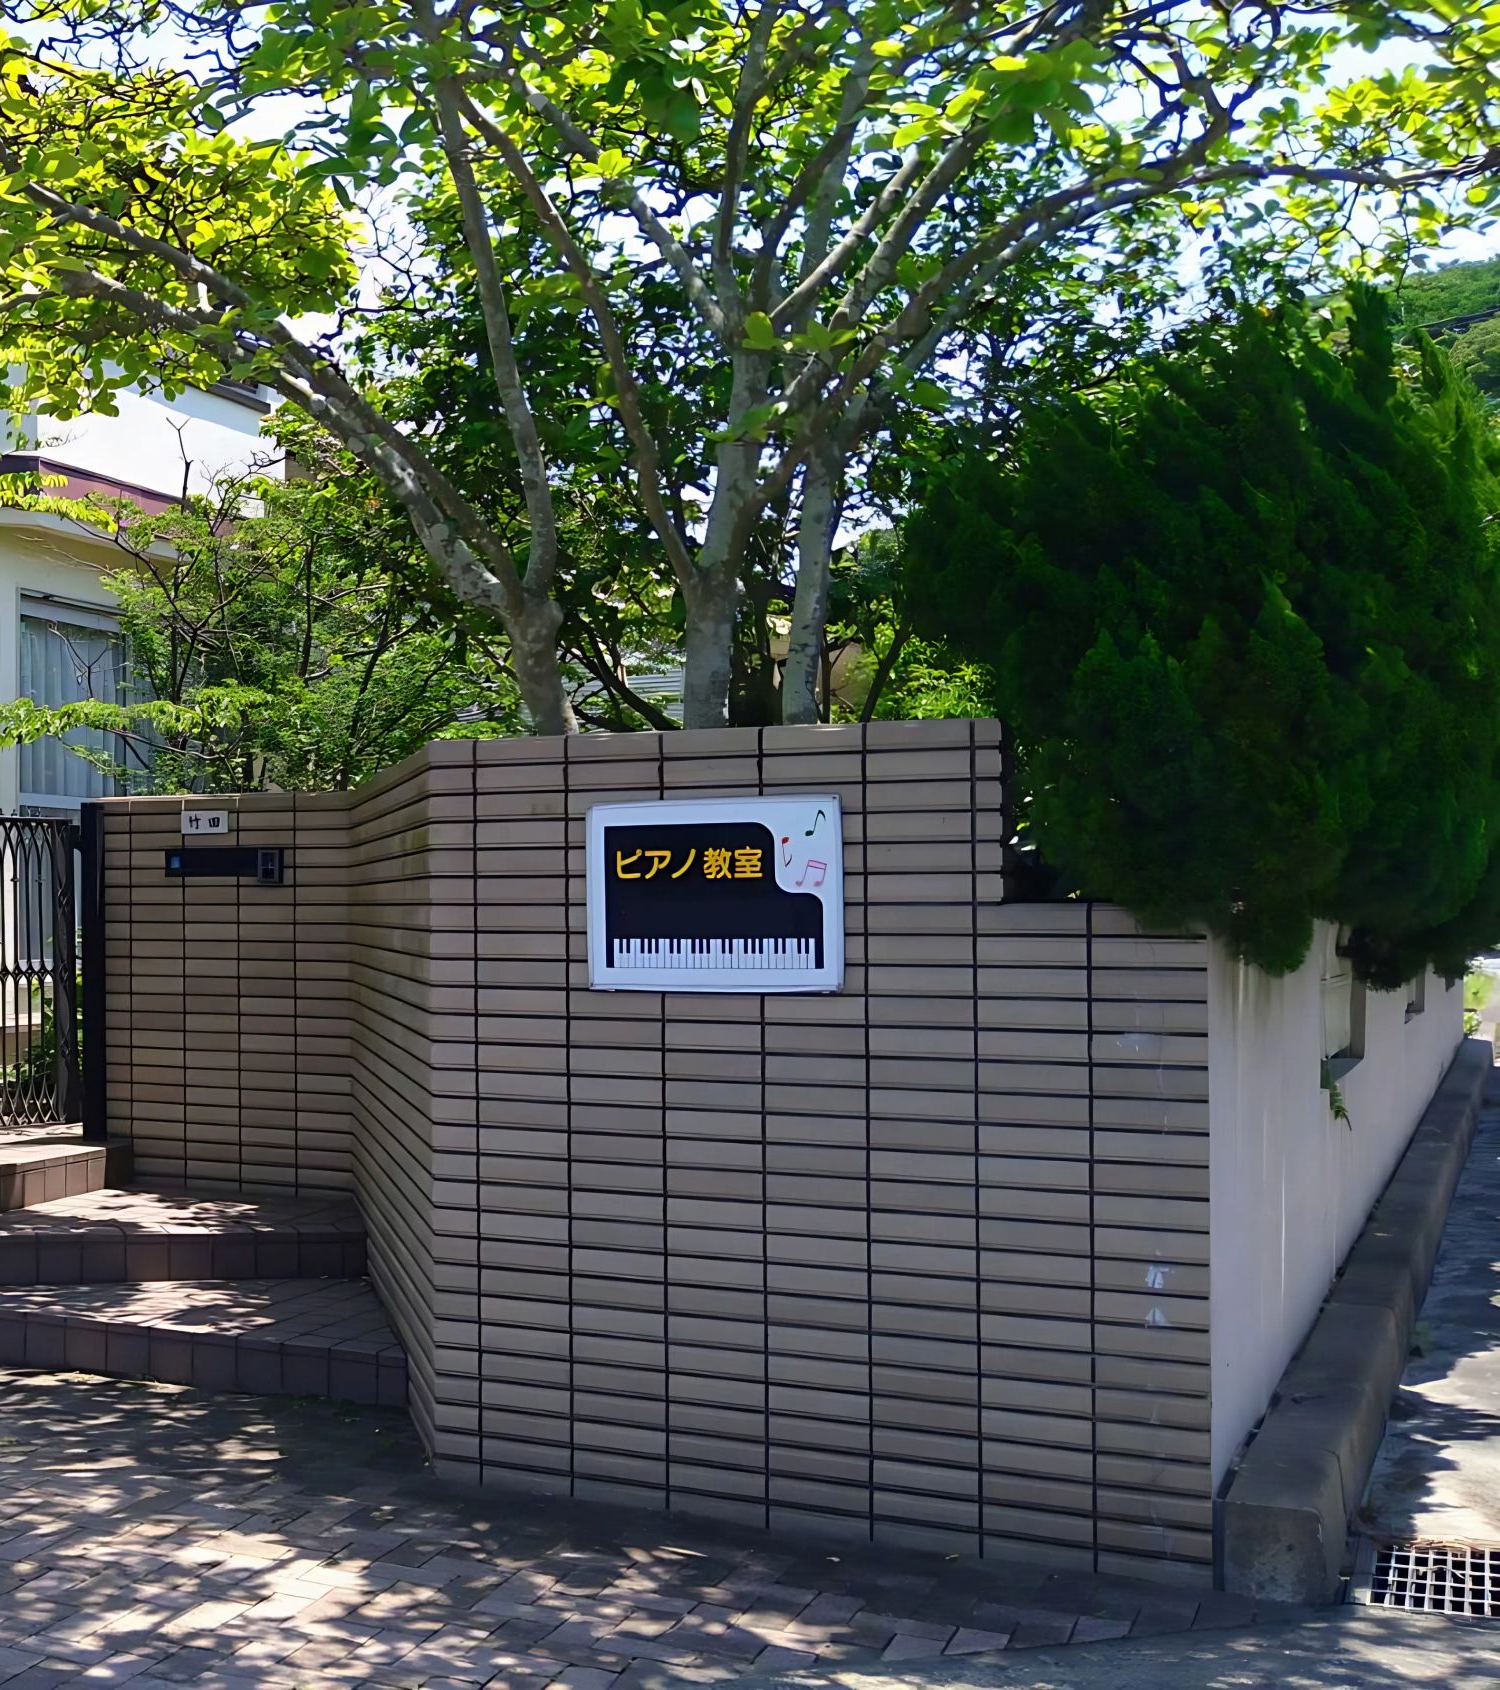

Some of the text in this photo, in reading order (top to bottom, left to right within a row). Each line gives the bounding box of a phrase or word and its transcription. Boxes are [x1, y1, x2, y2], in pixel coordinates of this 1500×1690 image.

[616, 846, 763, 879] ピアノ教室
